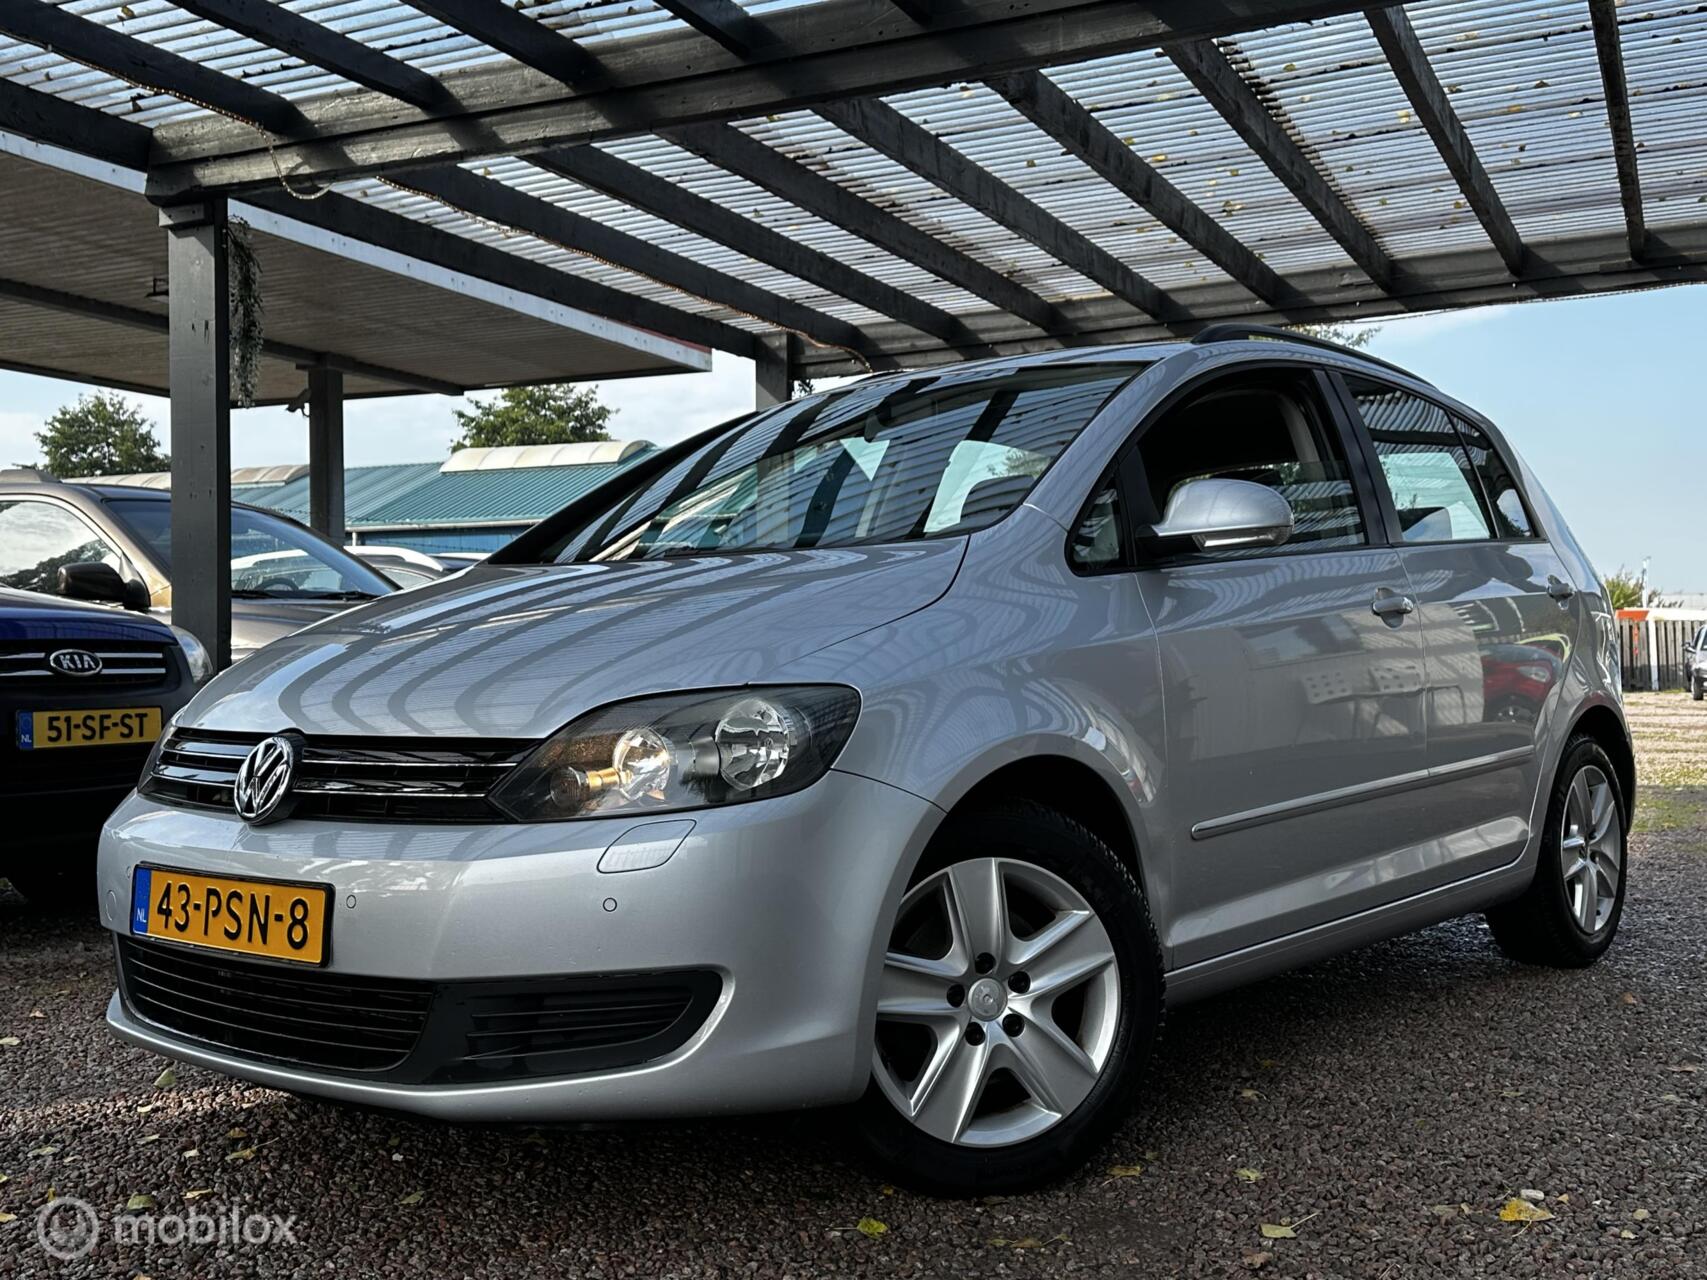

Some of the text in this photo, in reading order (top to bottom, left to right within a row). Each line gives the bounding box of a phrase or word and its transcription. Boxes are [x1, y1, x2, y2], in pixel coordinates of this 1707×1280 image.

[58, 654, 97, 670] KIA
[47, 713, 148, 743] 51-SF-ST
[21, 734, 32, 743] NL
[136, 908, 147, 923] NL
[157, 881, 309, 950] 43-PSN-8
